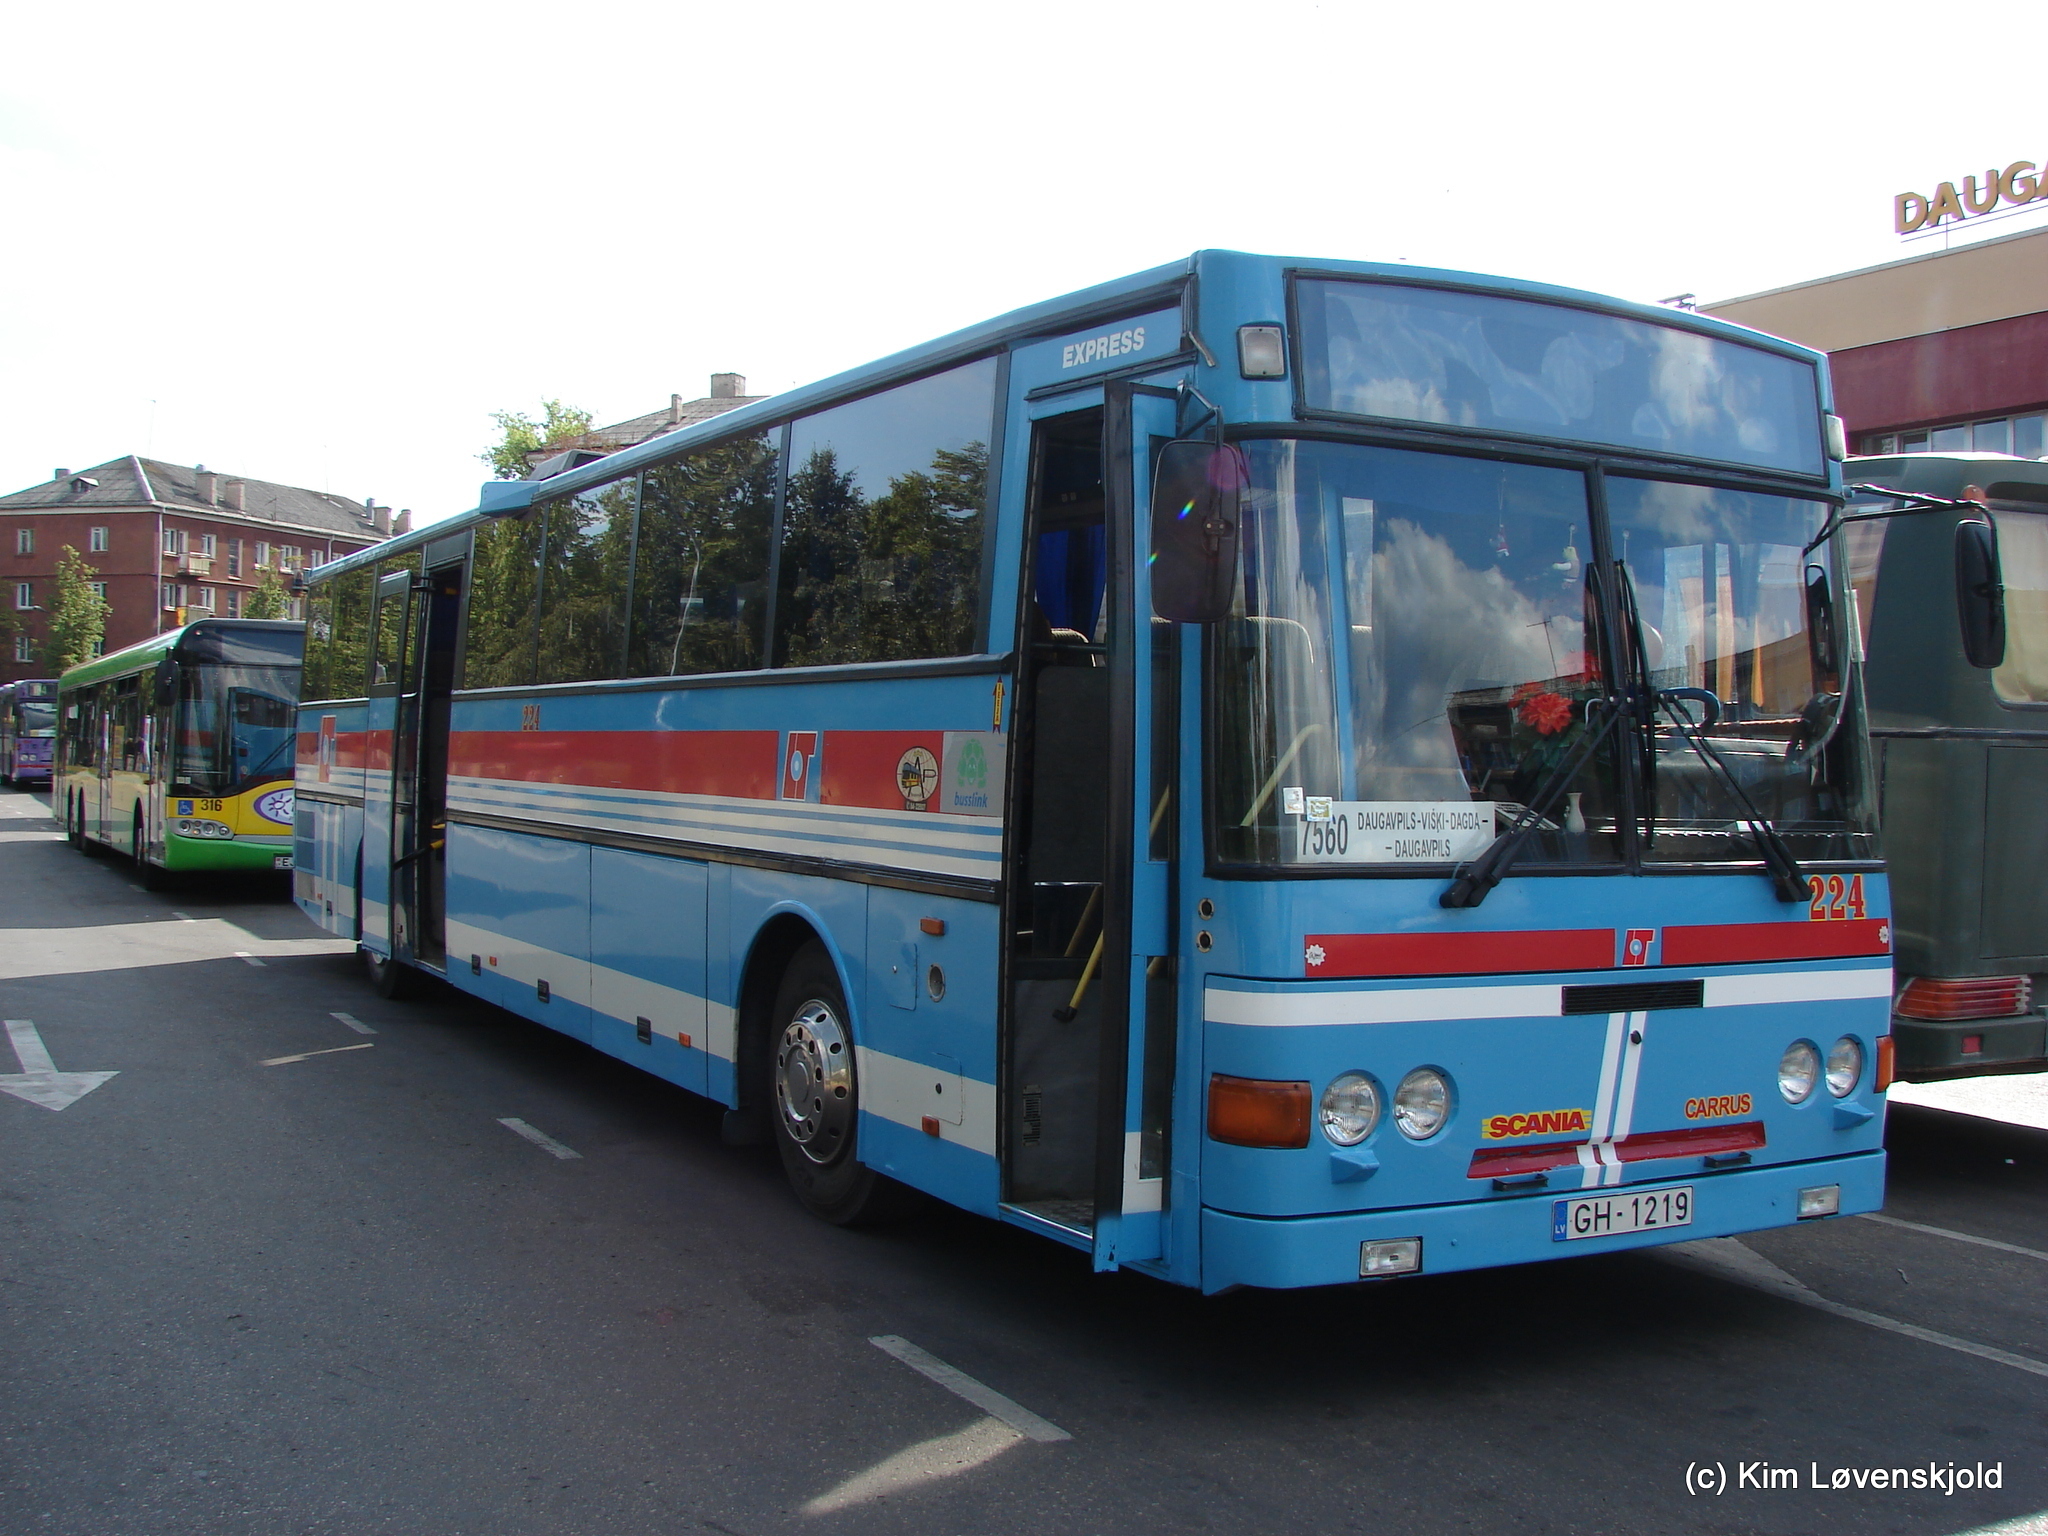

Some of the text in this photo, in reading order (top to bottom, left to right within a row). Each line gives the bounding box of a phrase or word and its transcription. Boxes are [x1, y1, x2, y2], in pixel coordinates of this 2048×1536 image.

[1062, 327, 1146, 369] EXPRESS
[522, 704, 541, 732] 224
[201, 799, 222, 811] 316
[954, 791, 988, 808] busslink
[1299, 814, 1348, 855] 7560
[1808, 874, 1866, 921] 224
[1685, 1093, 1752, 1119] CARRUS
[1489, 1110, 1585, 1139] SCANIA
[1554, 1223, 1566, 1234] LV
